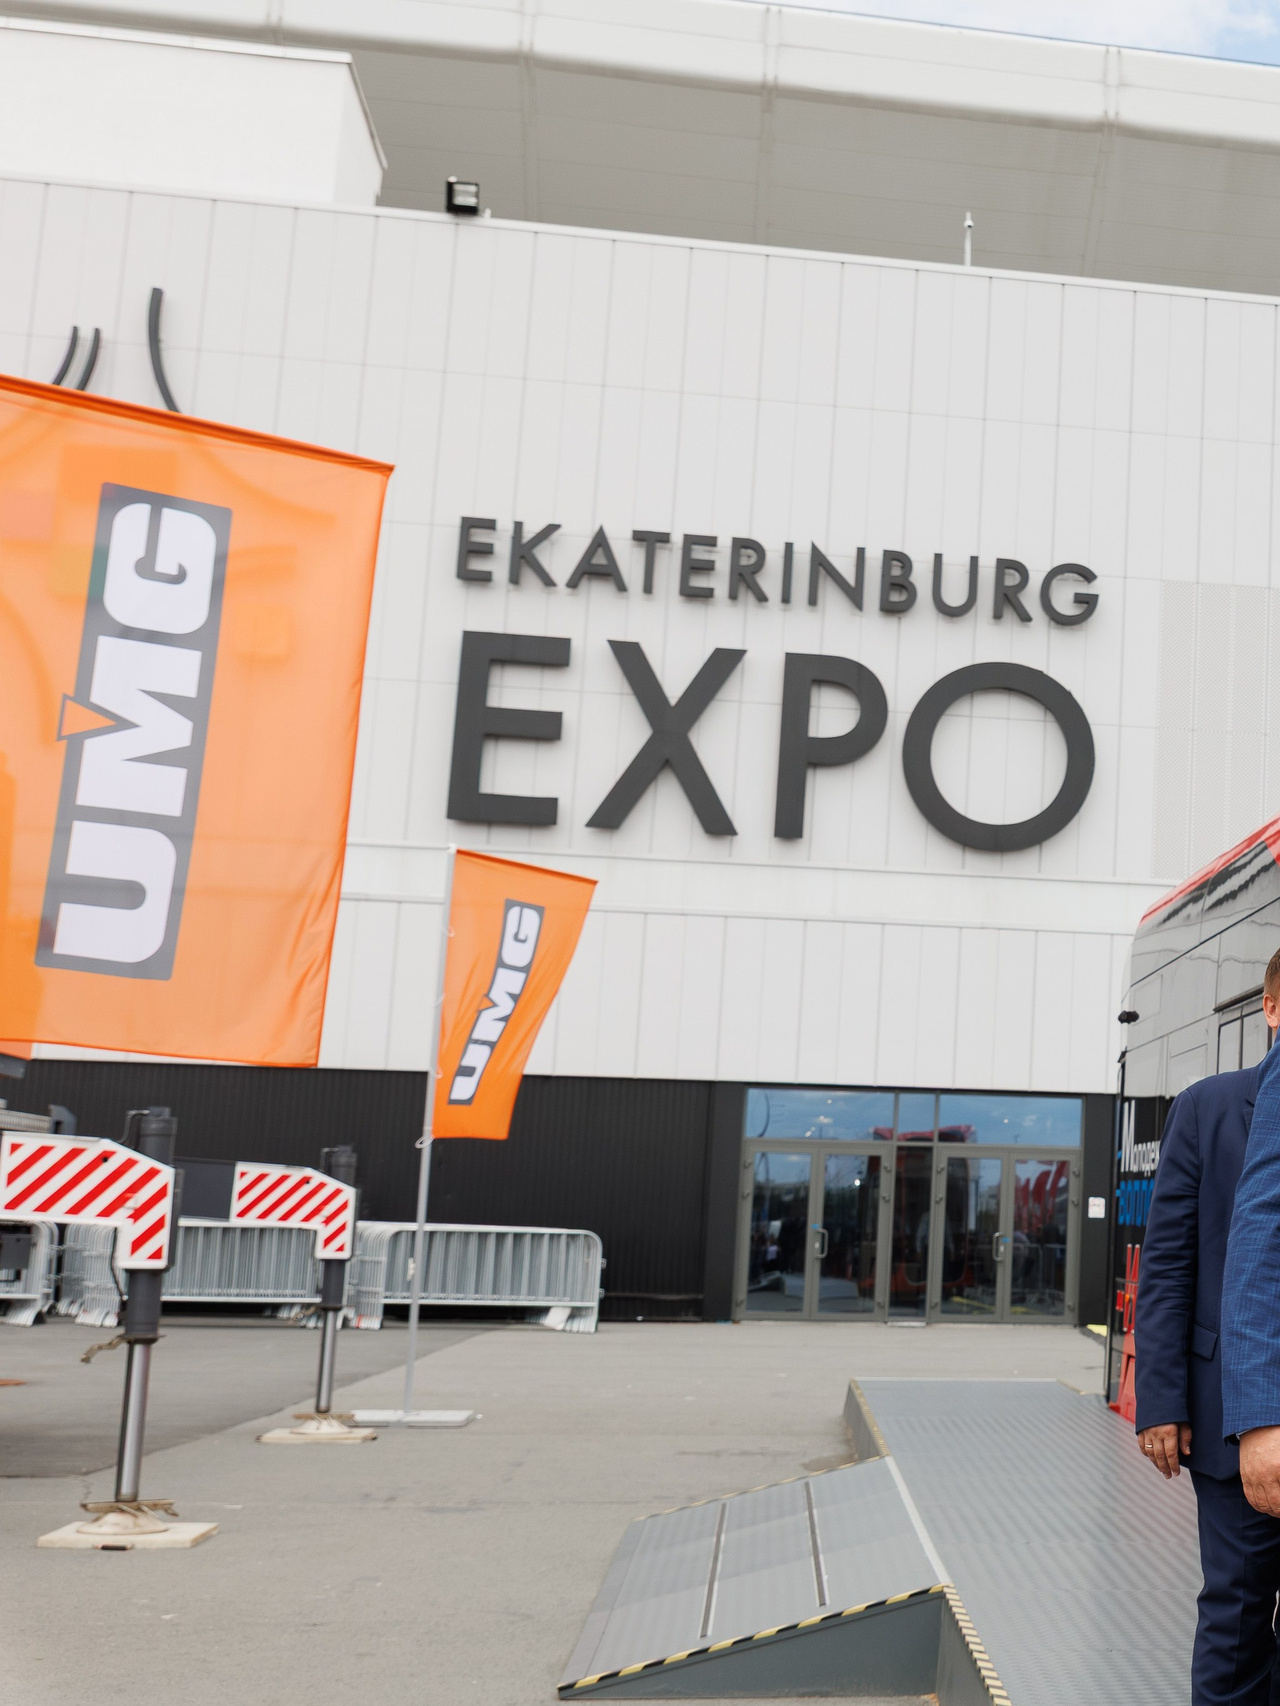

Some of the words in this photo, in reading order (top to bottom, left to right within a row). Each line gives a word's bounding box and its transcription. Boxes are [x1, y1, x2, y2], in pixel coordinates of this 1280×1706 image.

[455, 516, 1101, 627] EKATERINBURG
[52, 502, 218, 964] UMG
[446, 630, 1096, 853] EXPO
[450, 905, 541, 1101] UMG
